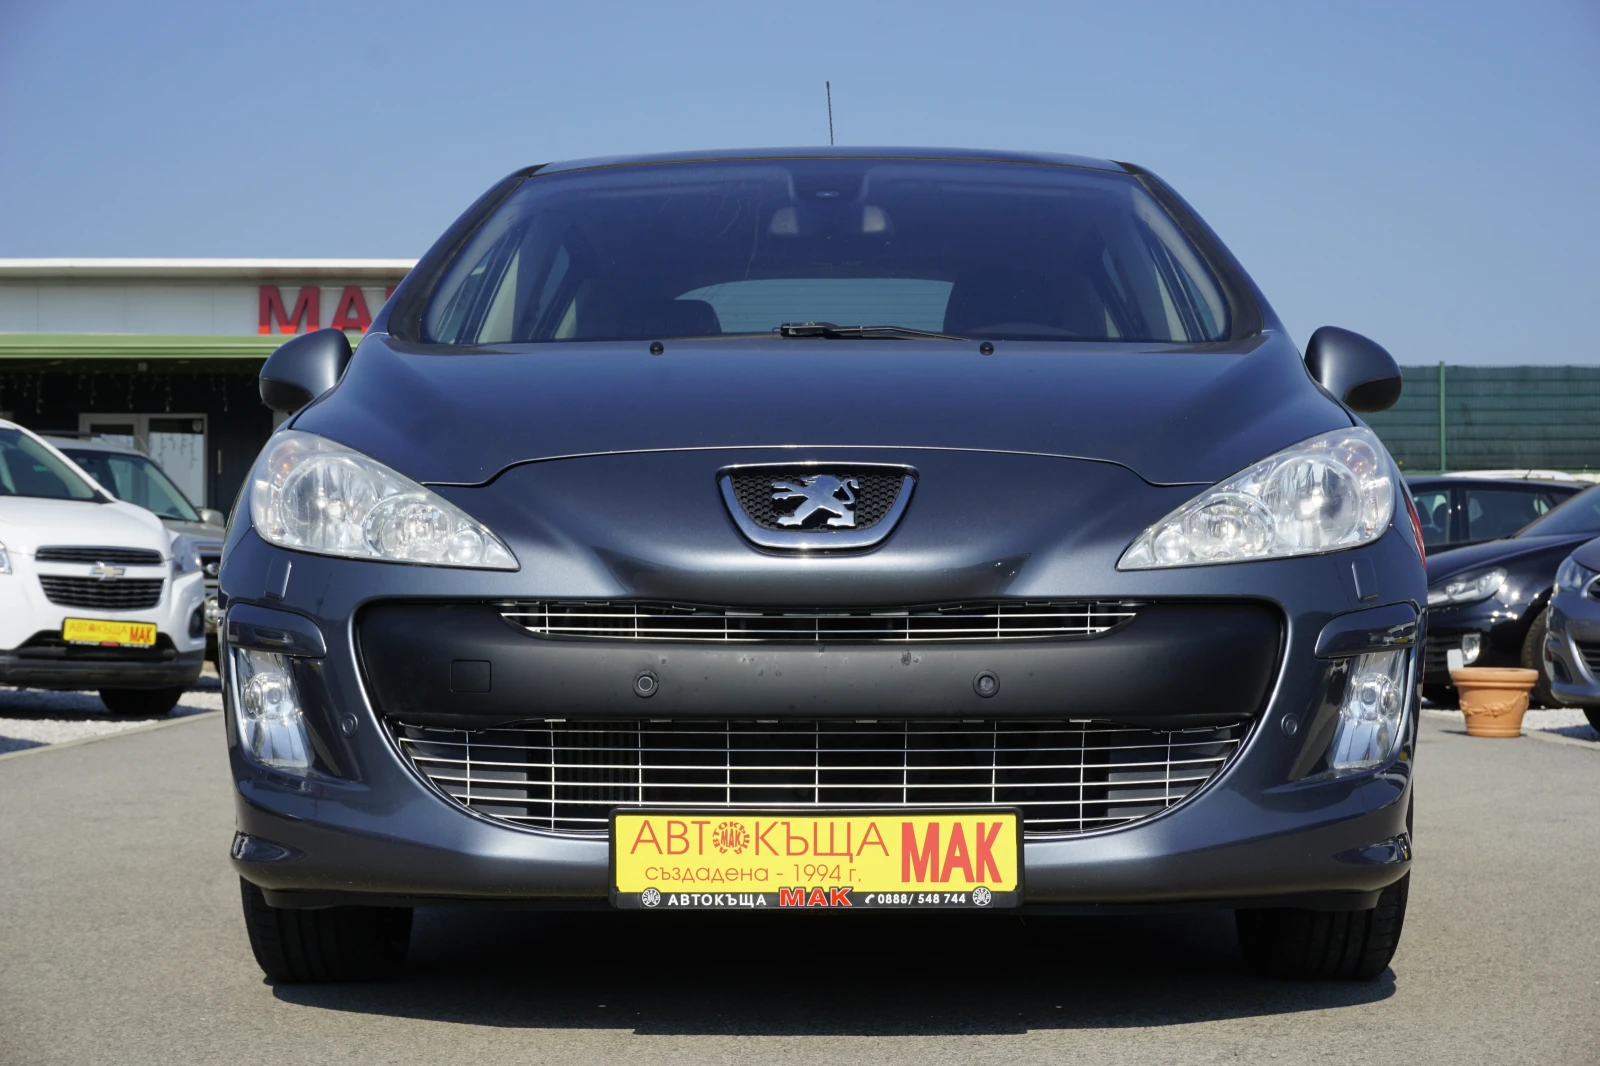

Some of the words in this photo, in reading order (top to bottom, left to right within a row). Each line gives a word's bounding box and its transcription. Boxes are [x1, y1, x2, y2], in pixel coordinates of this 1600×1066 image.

[258, 285, 397, 335] МА
[129, 626, 152, 643] МАК
[720, 828, 741, 848] МАК
[901, 821, 1003, 883] МАК
[645, 866, 769, 883] създадена
[793, 864, 841, 882] 1994
[849, 868, 861, 882] г.
[667, 893, 767, 908] АВТОКЪЩА
[779, 887, 852, 907] МАК
[877, 893, 914, 905] 0888/
[917, 893, 940, 904] 548
[943, 893, 966, 904] 744
